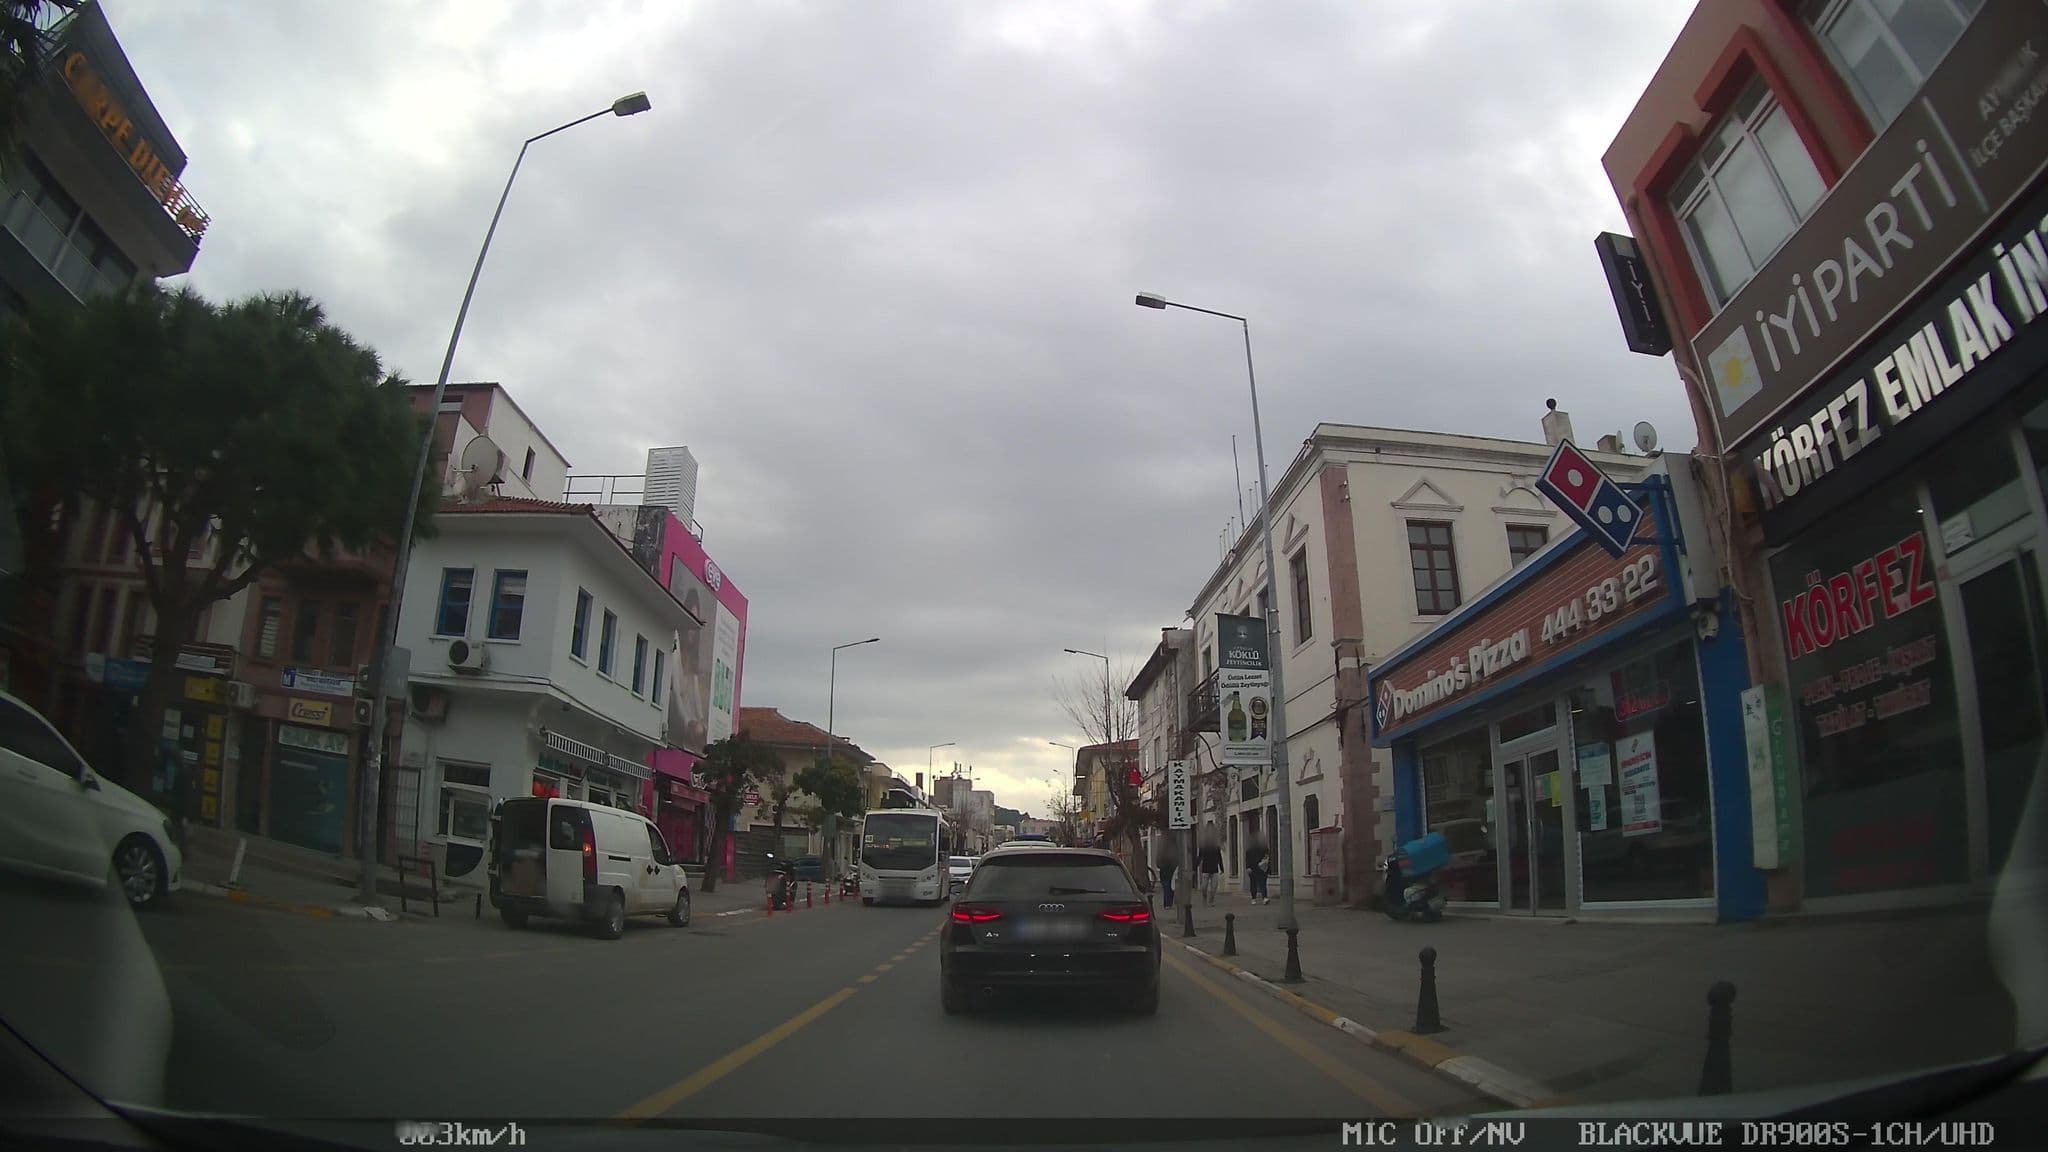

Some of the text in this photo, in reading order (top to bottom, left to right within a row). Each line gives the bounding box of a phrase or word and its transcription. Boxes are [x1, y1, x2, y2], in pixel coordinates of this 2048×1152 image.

[1753, 377, 1881, 510] KÖRFEZ
[1873, 271, 2015, 427] EMLAK
[1392, 553, 1659, 721] Domino's Pizza 444 33 22
[1783, 530, 1937, 661] KÖRFEZ
[1173, 761, 1185, 823] KAYMAKAMLIK
